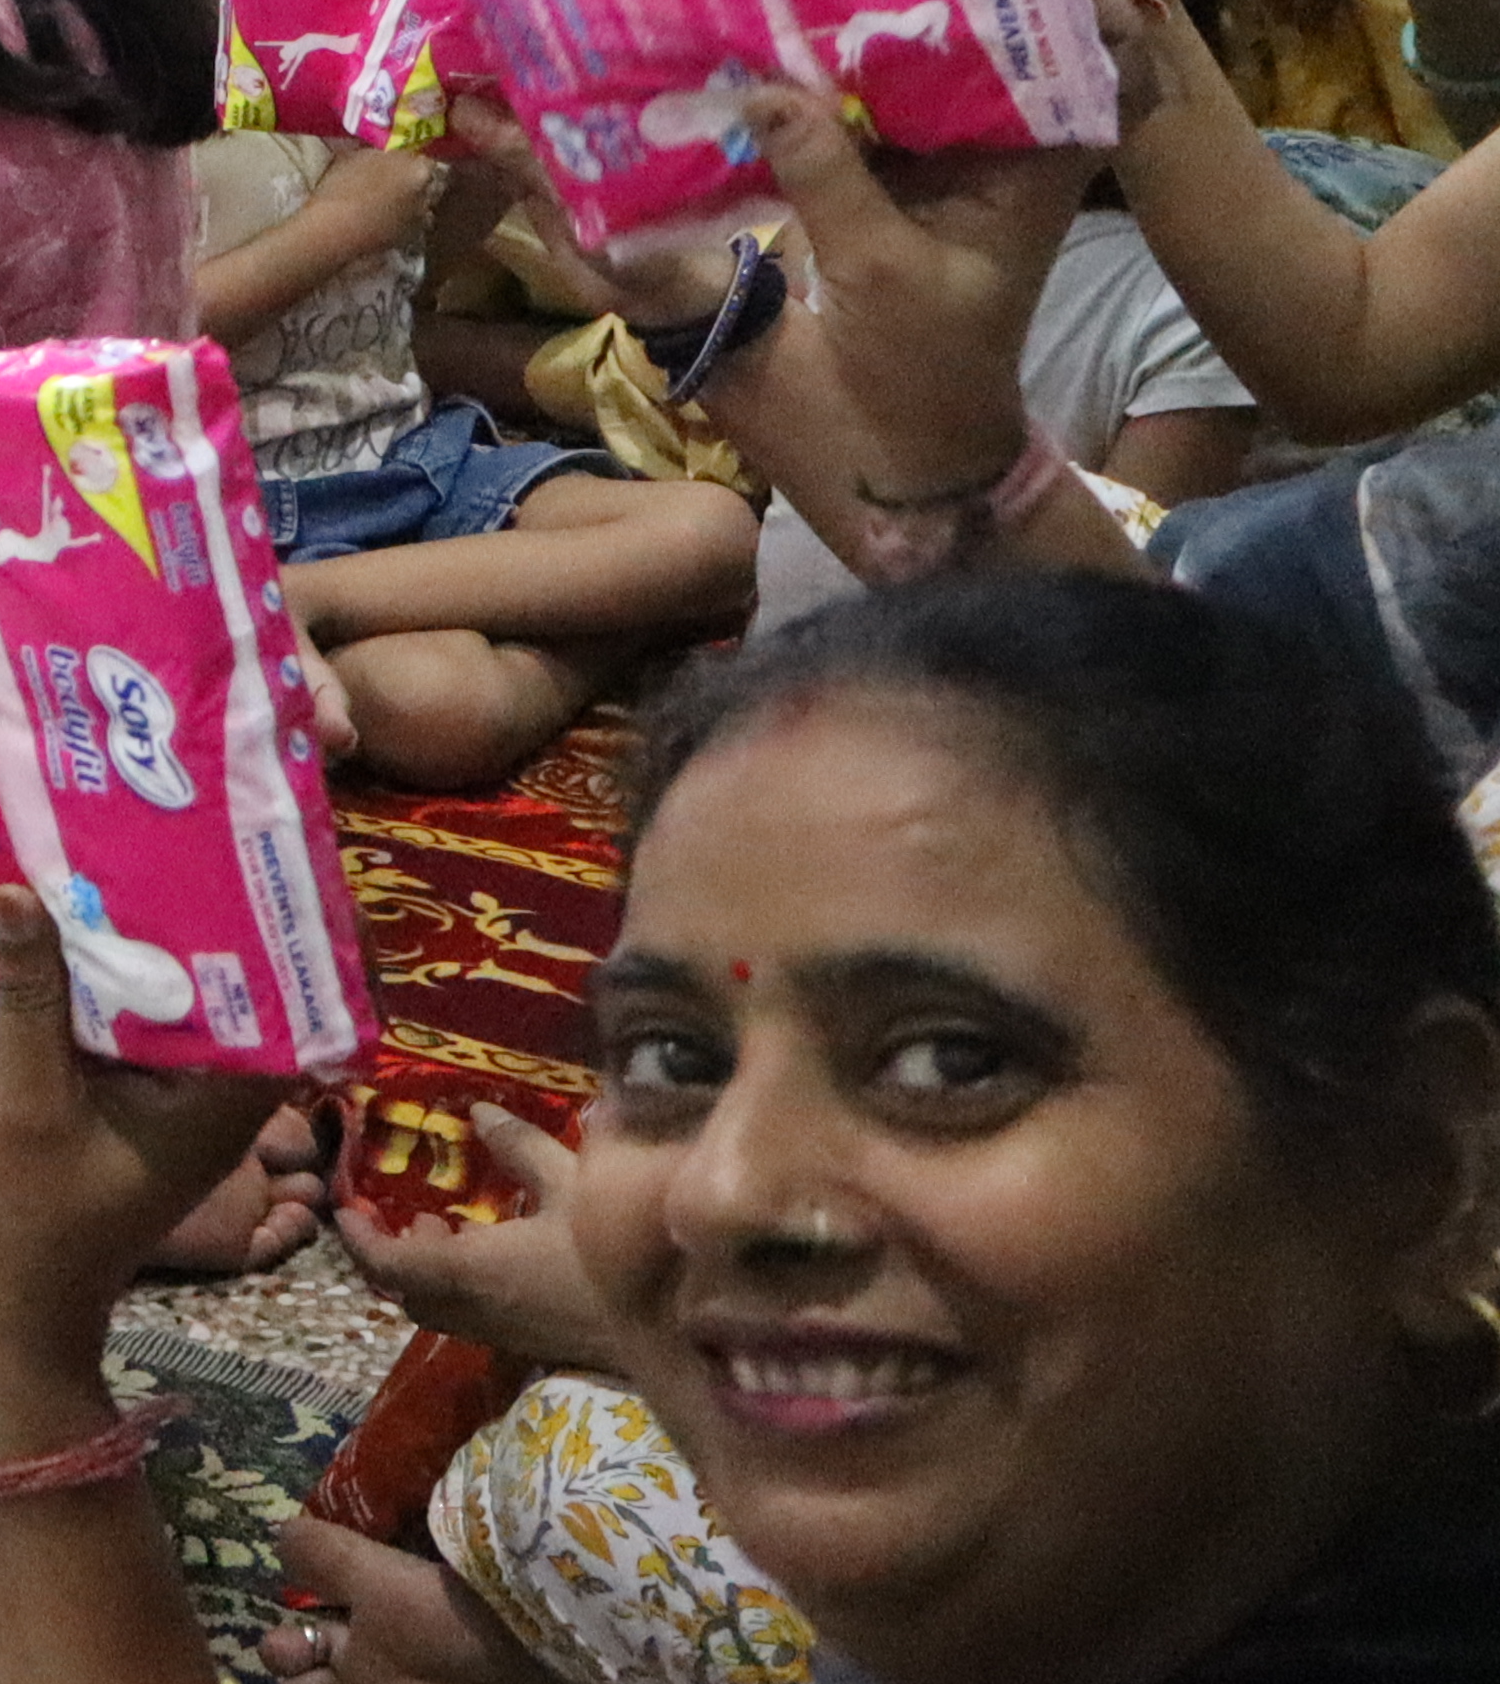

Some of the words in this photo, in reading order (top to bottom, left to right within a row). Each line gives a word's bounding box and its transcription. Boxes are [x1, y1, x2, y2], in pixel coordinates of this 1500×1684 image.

[46, 643, 108, 790] bodyfit
[110, 672, 158, 773] SOFY
[259, 829, 297, 937] PREVENTS
[287, 937, 323, 1034] LEAKAGE
